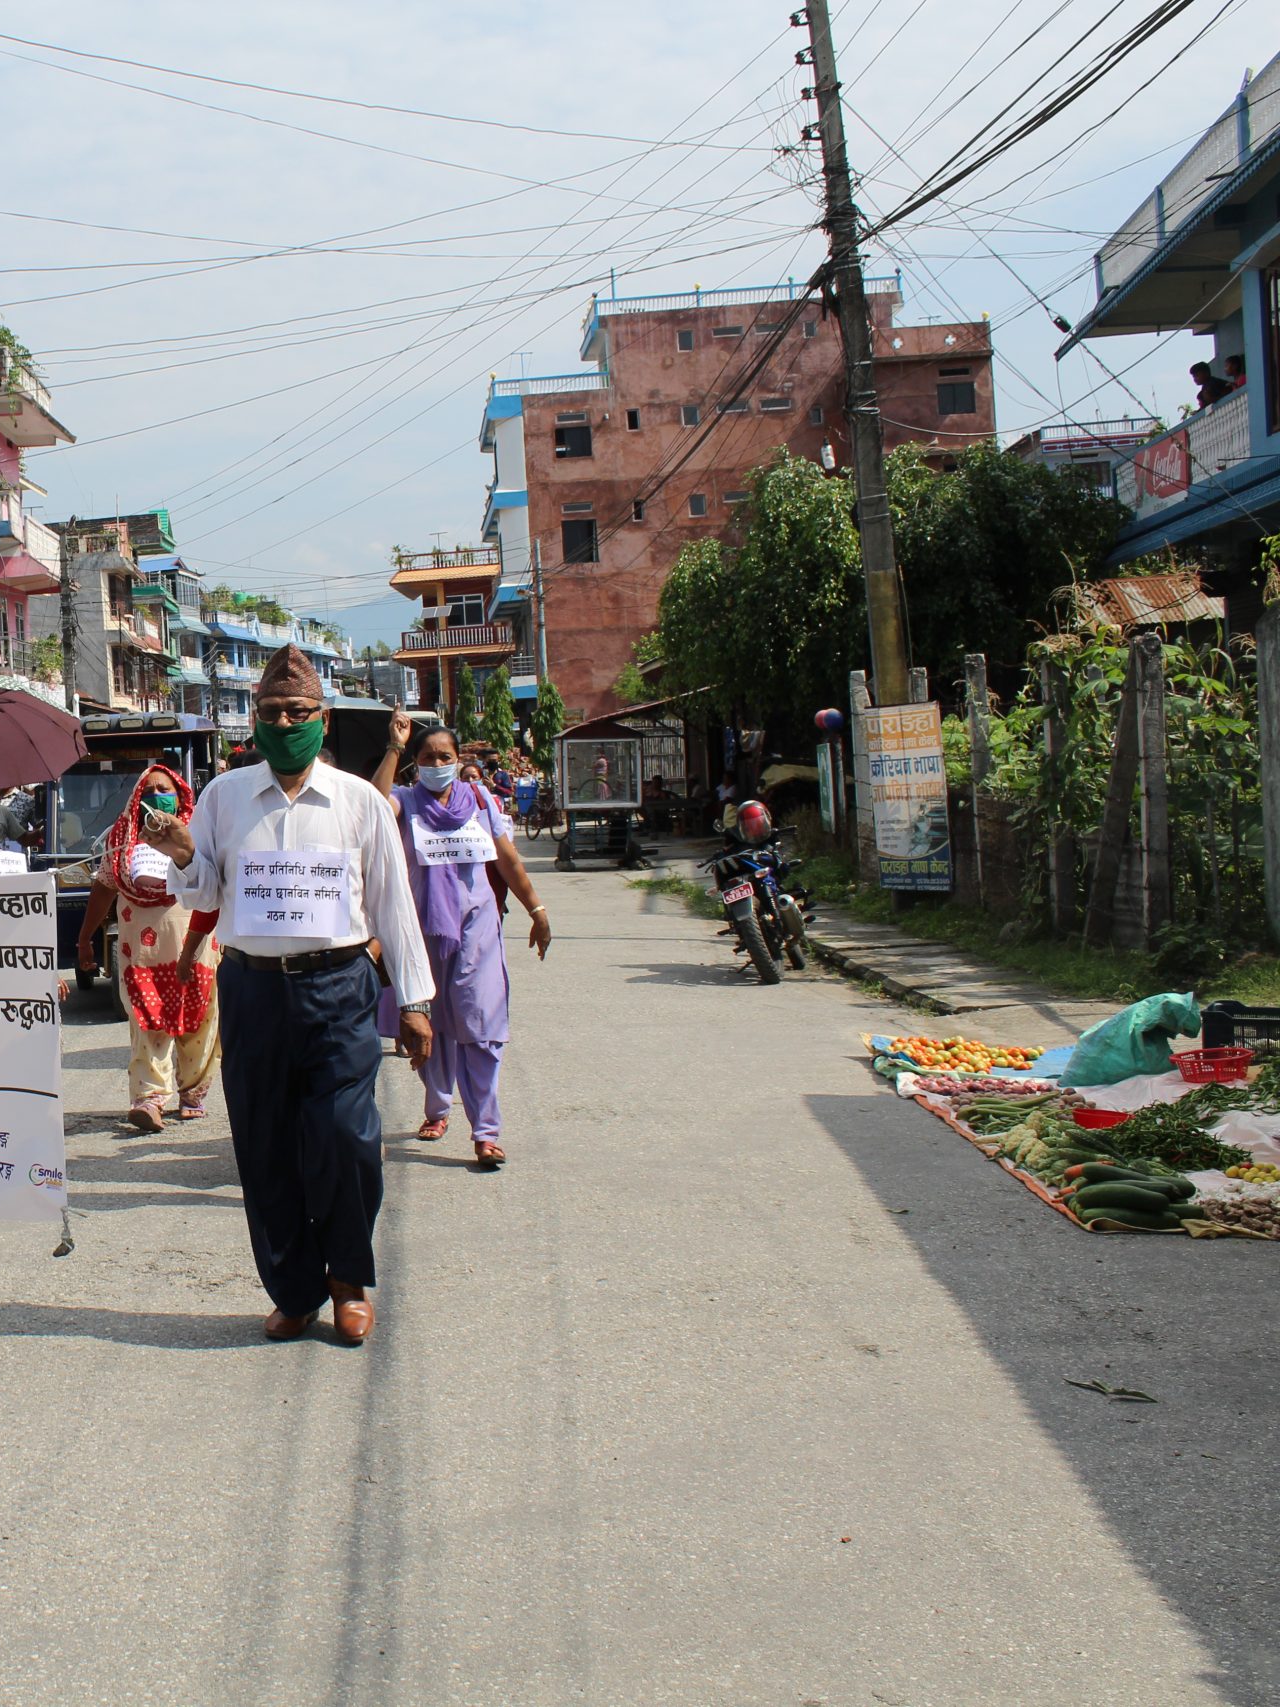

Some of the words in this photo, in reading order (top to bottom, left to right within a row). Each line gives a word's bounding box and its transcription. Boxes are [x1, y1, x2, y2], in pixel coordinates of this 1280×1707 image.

[244, 861, 265, 876] दलित
[269, 860, 306, 876] प्रतिनिधि
[314, 886, 342, 901] समिति
[267, 911, 286, 921] गठन
[290, 911, 304, 923] गर
